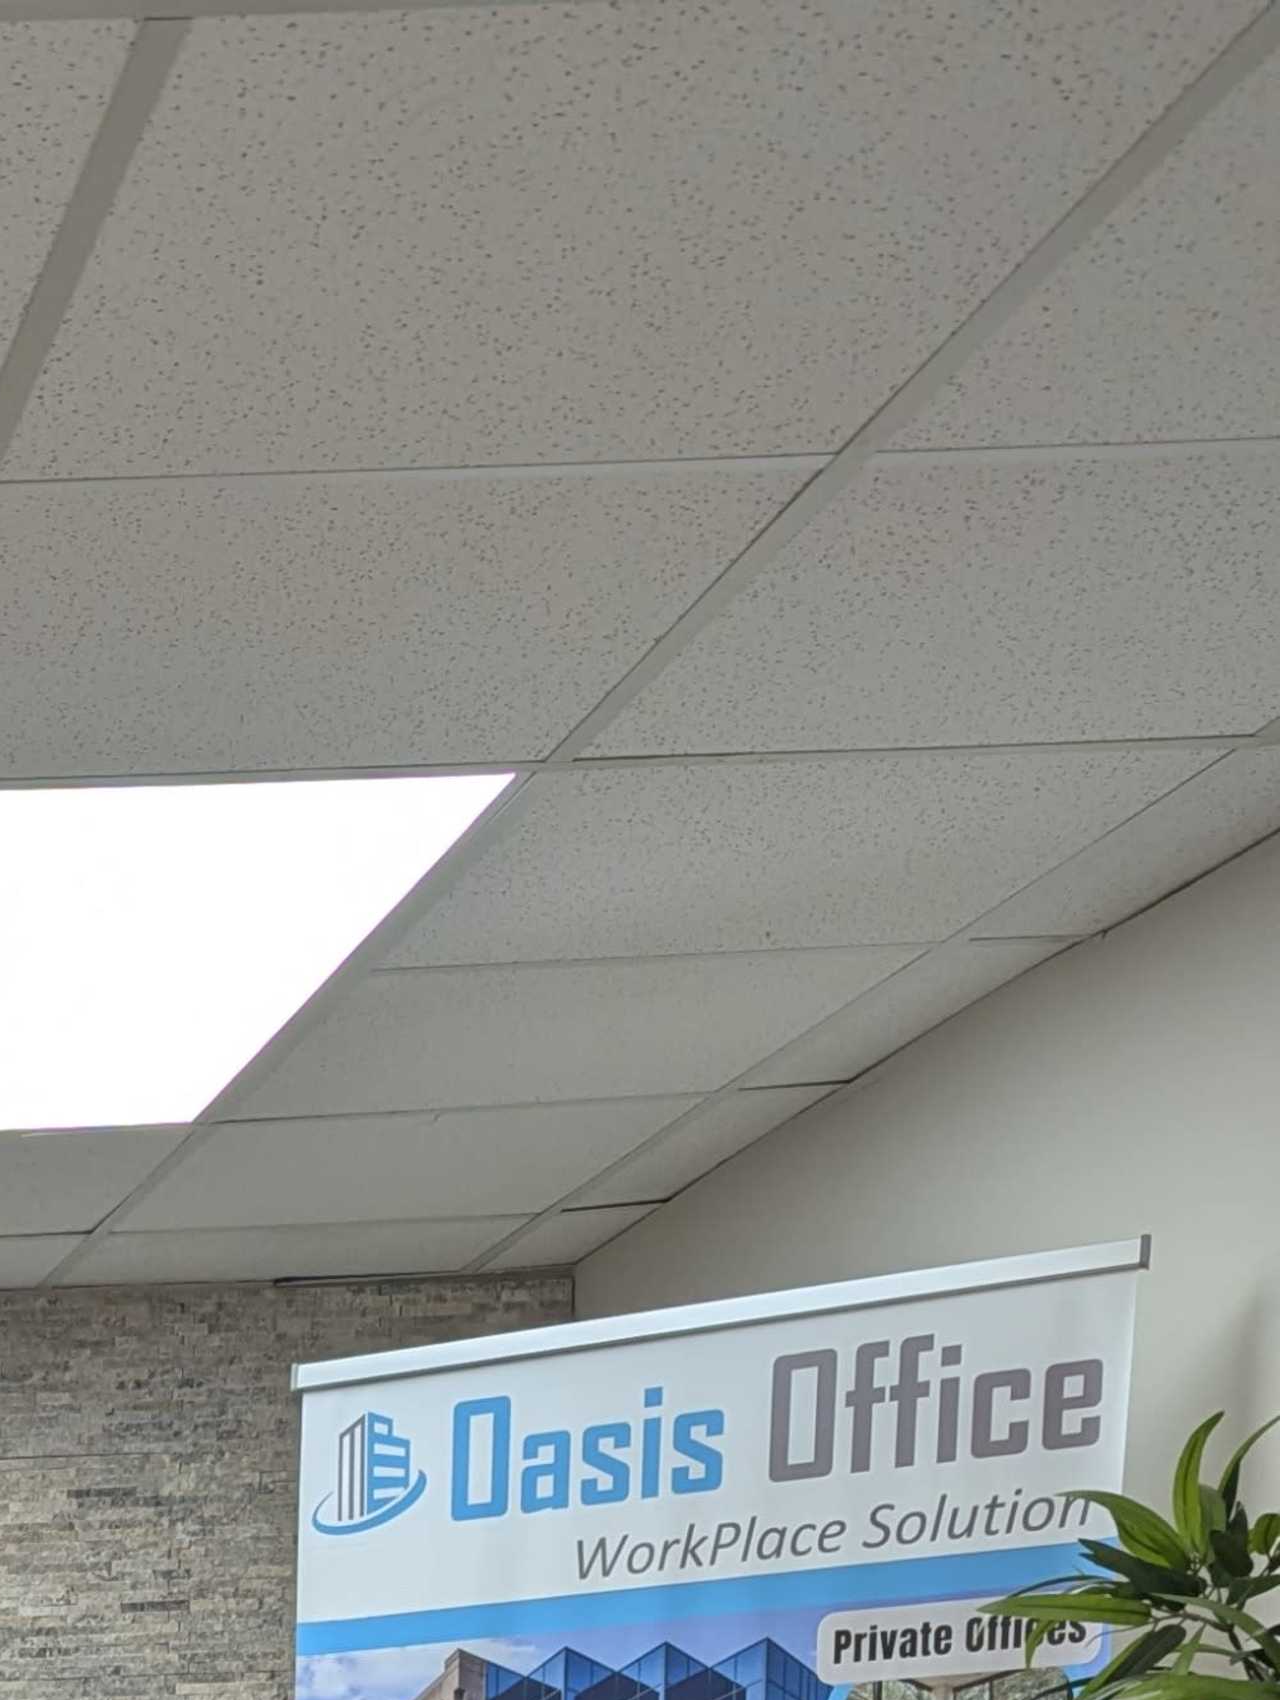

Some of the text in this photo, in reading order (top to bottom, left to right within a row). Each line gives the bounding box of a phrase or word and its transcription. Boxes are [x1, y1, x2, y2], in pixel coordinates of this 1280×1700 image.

[450, 1333, 1104, 1522] Oasis Office
[576, 1488, 1091, 1580] WorkPlace Solution
[833, 1621, 953, 1664] Private
